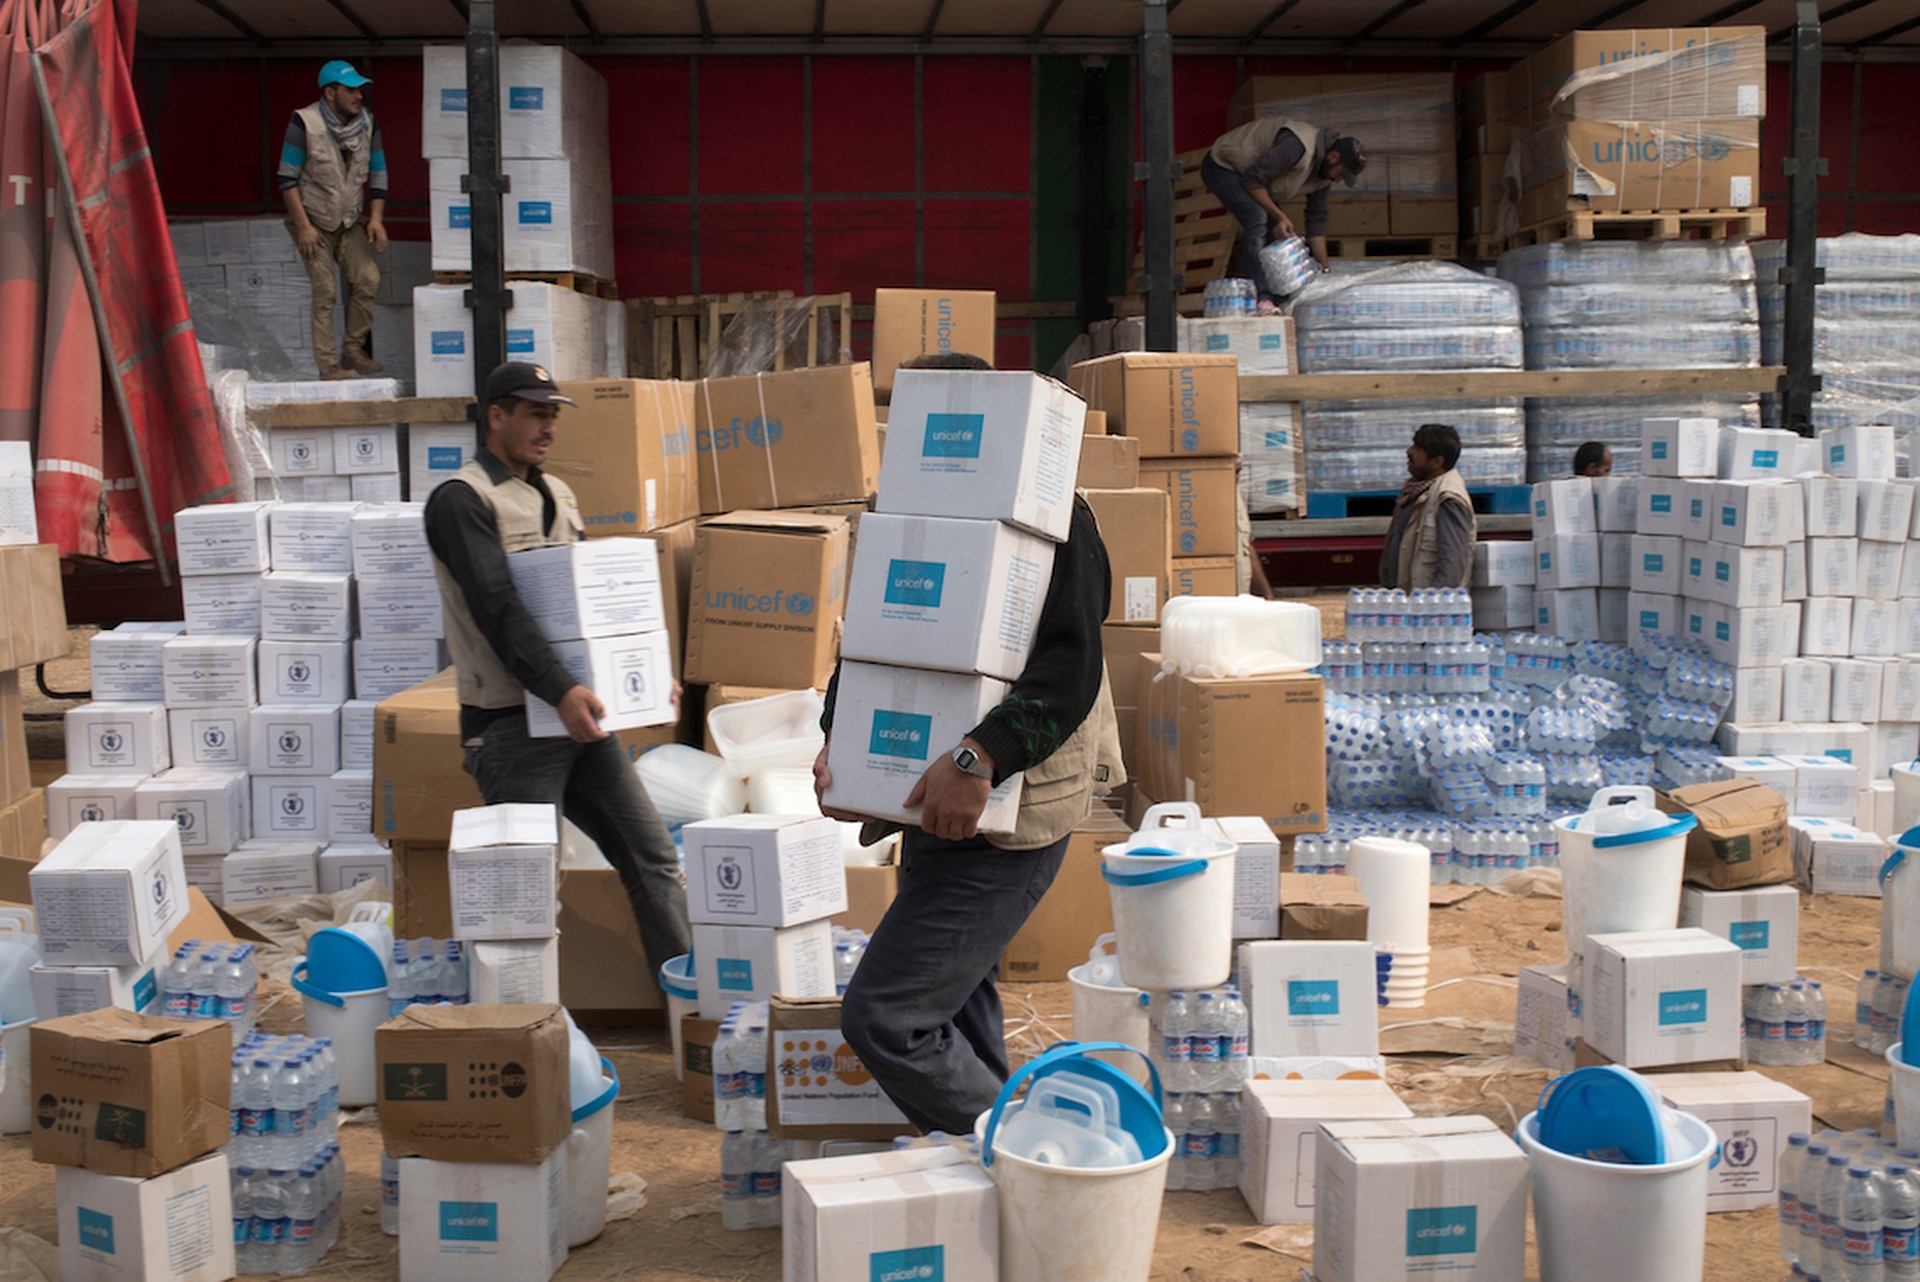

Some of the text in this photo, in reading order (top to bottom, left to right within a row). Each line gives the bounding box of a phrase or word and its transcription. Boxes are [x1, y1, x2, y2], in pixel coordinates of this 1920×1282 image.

[1594, 131, 1690, 164] unicef
[1180, 368, 1200, 427] unicef
[696, 417, 741, 453] cef
[932, 429, 962, 442] unicef
[1178, 470, 1199, 528] unicef
[583, 510, 622, 526] unicef
[894, 577, 923, 590] unicef
[705, 587, 783, 613] unicef
[705, 617, 815, 633] FROM UNICEF SUPPLY DIVISION
[879, 727, 909, 741] unicef
[1268, 813, 1305, 826] unicef
[1665, 1002, 1691, 1013] unicef
[833, 1055, 865, 1072] UNF
[447, 1215, 477, 1227] unicef
[1416, 1223, 1453, 1238] unicef
[881, 1264, 919, 1282] unicef
